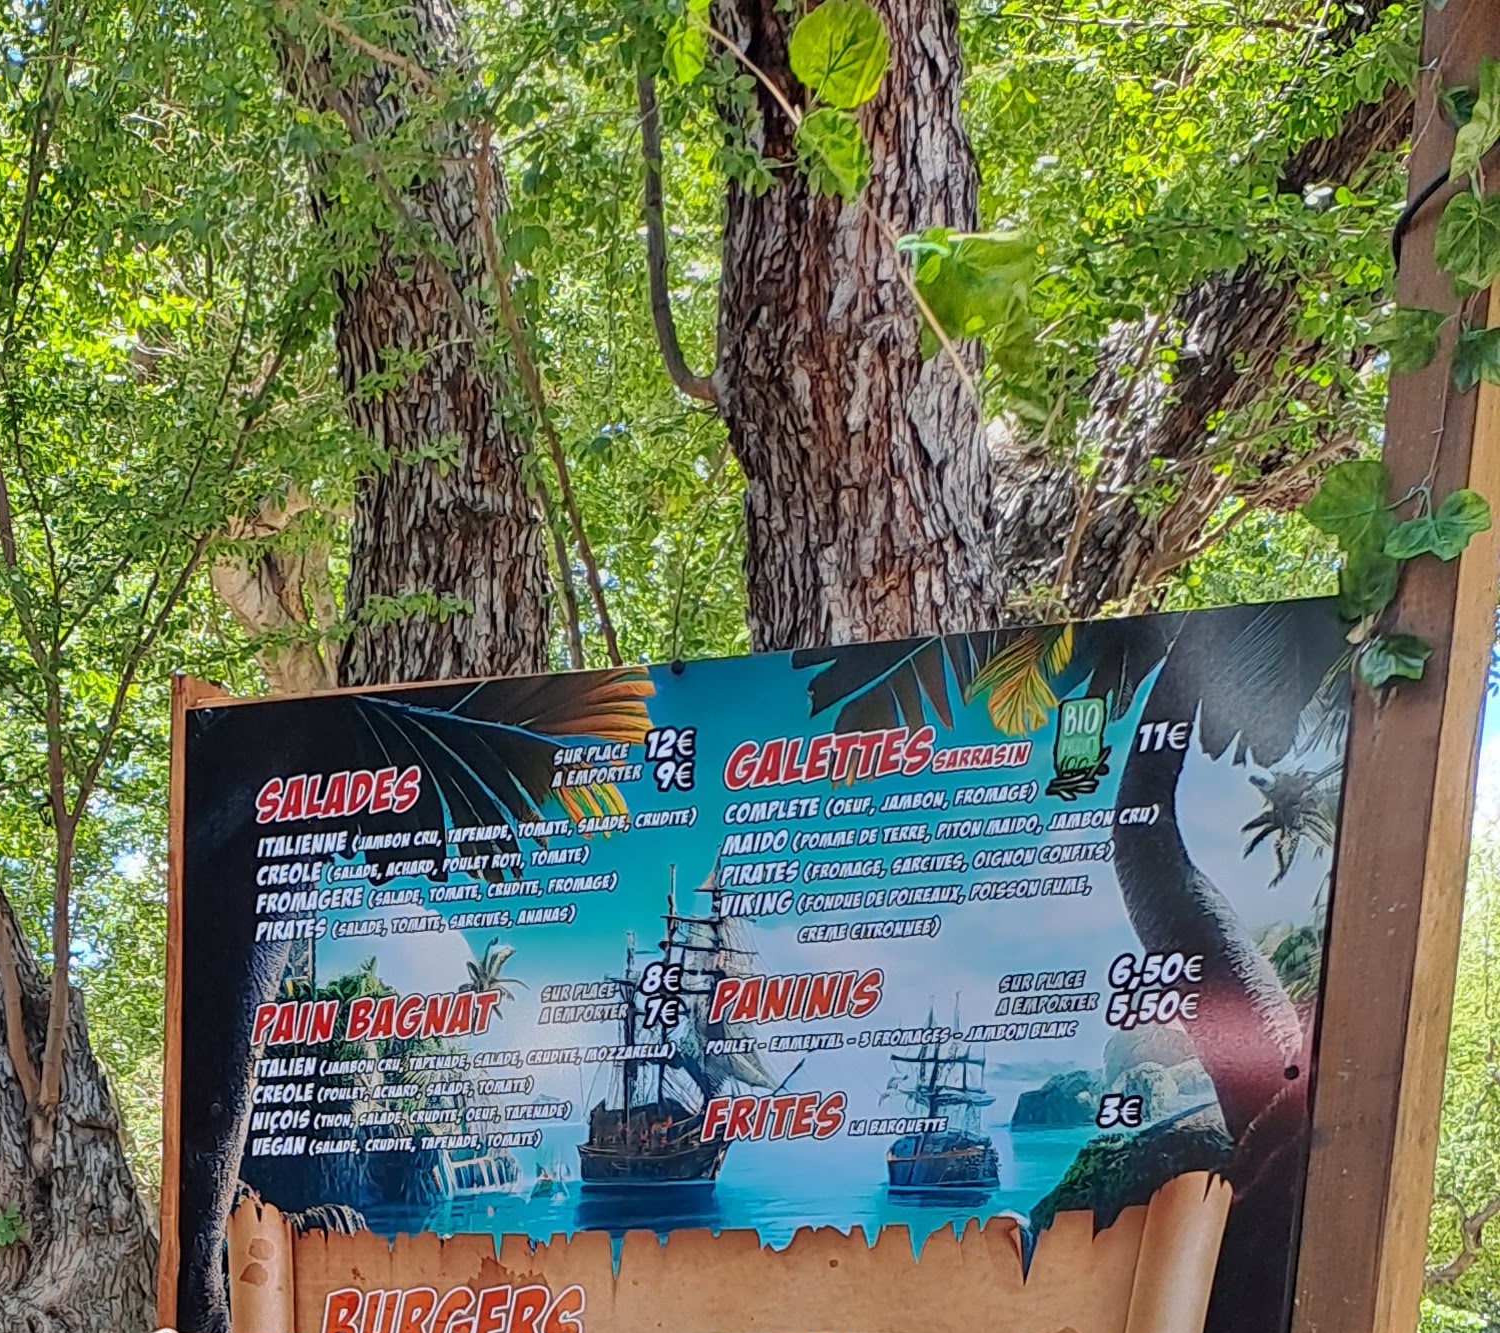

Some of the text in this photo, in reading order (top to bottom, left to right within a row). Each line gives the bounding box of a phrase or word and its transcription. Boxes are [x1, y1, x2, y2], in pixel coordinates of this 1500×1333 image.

[1064, 704, 1100, 736] BIO
[1138, 722, 1189, 752] 11€
[553, 728, 695, 765] SUR PLACE 12€
[724, 725, 936, 790] GALETTES
[932, 742, 1032, 772] SARRASIN
[551, 761, 693, 789] A EMPORTER 9€
[255, 765, 421, 824] SALADES
[724, 782, 1039, 823] COMPLETE JAMBON, FROMAGE)
[257, 807, 697, 857] ITALIENNE TAPENADE, TOMATE, SALADE, CRUDITE)
[722, 804, 1160, 856] MAIDO (POMME DE TERRE, PITON MAIDO, JAMBON CRU)
[256, 846, 589, 886] CREOLE ACHARD, POULET ROTI, TOMATE)
[720, 839, 1116, 886] PIRATES (FROMAGE, SARCIVES, OIGNON CONFITS)
[256, 873, 618, 914] FROMAGERE TOMATE, CRUDITE, FROMAGE)
[719, 876, 1092, 917] VIKING (FONDUE DE POIREAUX, POISSON FUME,
[255, 917, 327, 942] PIRATES
[391, 916, 445, 933] TOMATE,
[517, 905, 577, 924] ANANAS)
[799, 915, 940, 943] CREME CITRONNEE)
[542, 965, 680, 1002] SUR PLACE 8€
[999, 954, 1204, 993] SUR PLACE 6,50€
[538, 997, 678, 1027] A EMPORTER 7€
[709, 969, 884, 1024] PANINIS
[995, 992, 1200, 1028] A EMPORTER 5,50€
[251, 988, 501, 1045] PAIN BAGNAT
[706, 1021, 1078, 1055] POULET EMMENTAL 3 FROMAGES JAMBON BLANC
[253, 1043, 676, 1077] ITALIEN CRUDITE, MOZZARELLA)
[253, 1075, 534, 1103] CREOLE ACHARD, SALADE, TOMATE)
[252, 1101, 572, 1133] NIÇOIS SALADE, TAPENADE)
[700, 1092, 948, 1143] FRITES LA BARQUETTE
[1098, 1096, 1141, 1126] 3€
[251, 1135, 415, 1156] VEGAN CRUDITE,
